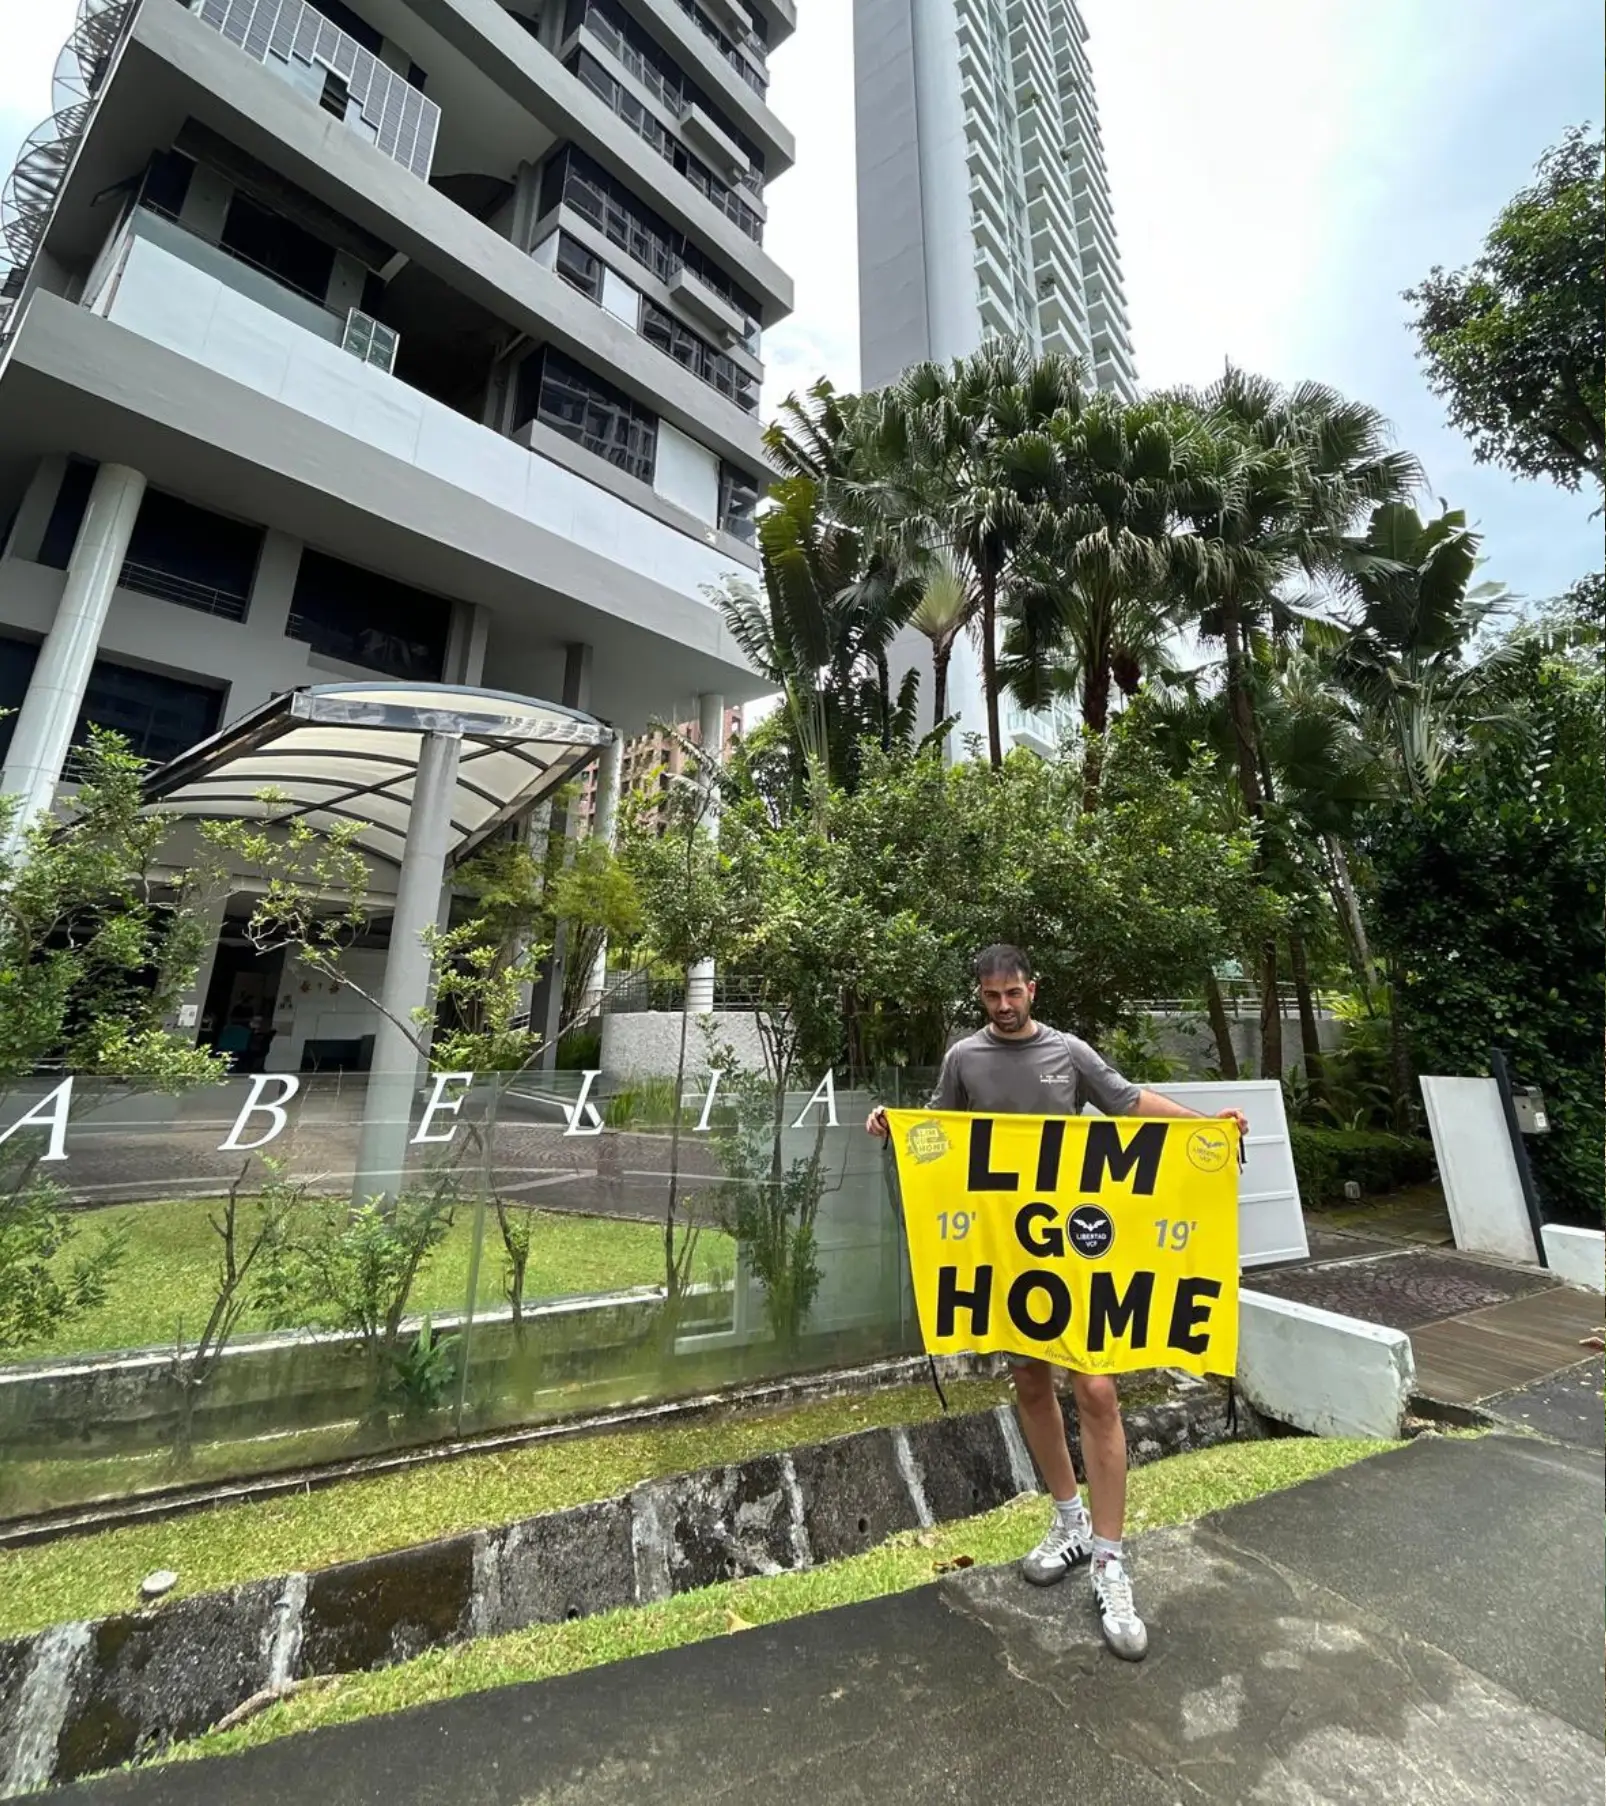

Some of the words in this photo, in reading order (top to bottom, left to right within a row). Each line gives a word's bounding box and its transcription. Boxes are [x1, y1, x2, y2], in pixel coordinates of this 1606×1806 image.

[0, 1068, 839, 1161] ABELIA
[968, 1119, 1169, 1195] LIM
[937, 1211, 976, 1240] 19'
[1155, 1219, 1197, 1251] 19'
[936, 1264, 1222, 1355] HOME
